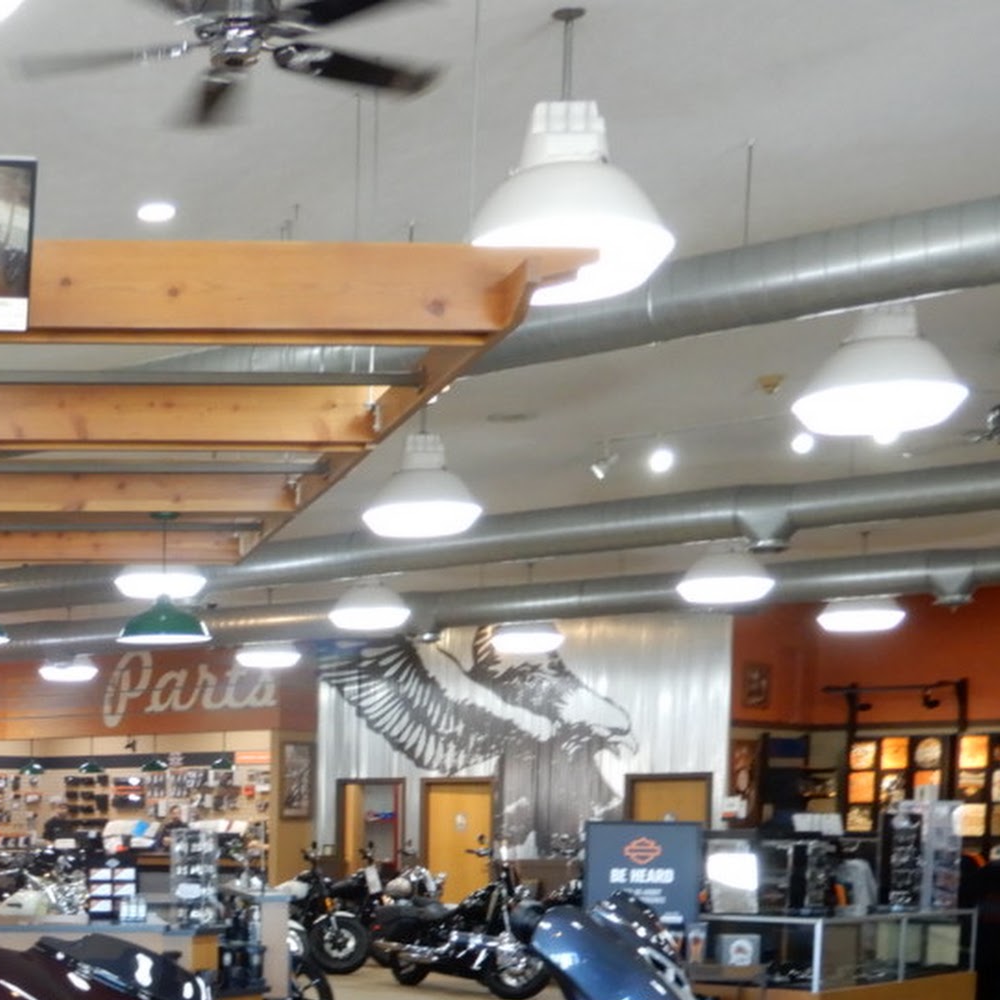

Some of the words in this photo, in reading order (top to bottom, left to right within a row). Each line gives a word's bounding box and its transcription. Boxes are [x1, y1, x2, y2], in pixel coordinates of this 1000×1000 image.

[103, 650, 277, 728] Parts
[609, 868, 628, 883] BE
[629, 868, 675, 883] HEARD
